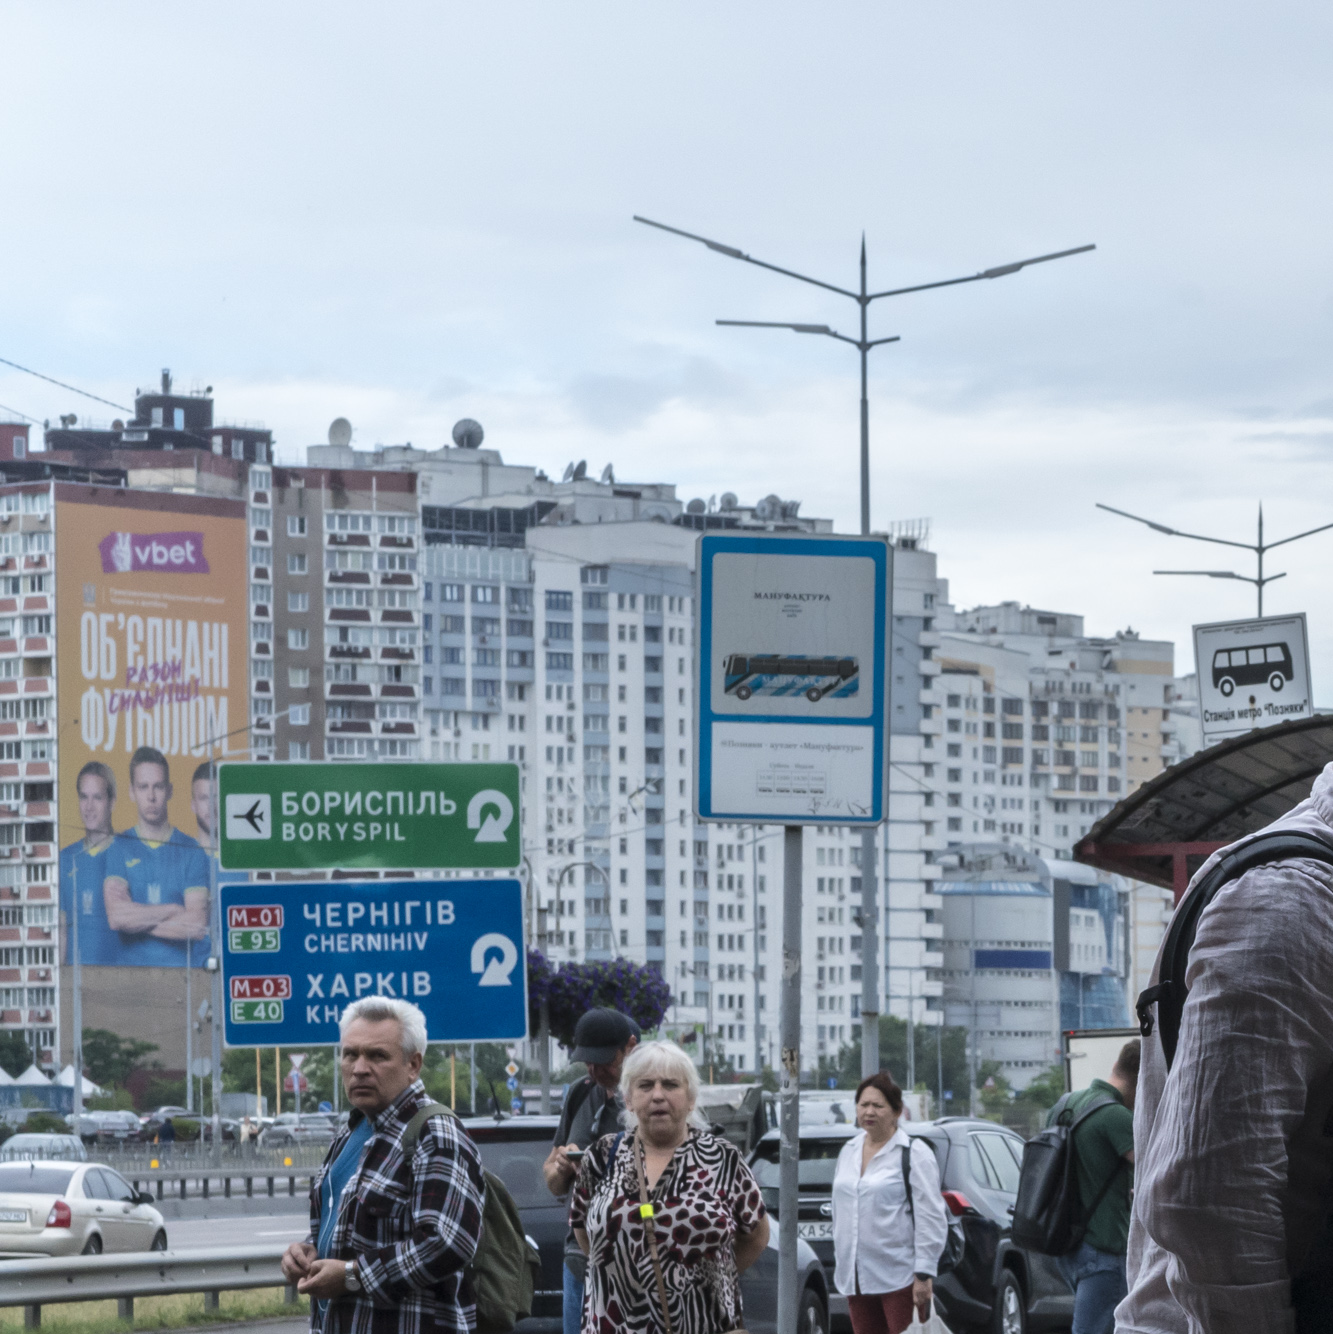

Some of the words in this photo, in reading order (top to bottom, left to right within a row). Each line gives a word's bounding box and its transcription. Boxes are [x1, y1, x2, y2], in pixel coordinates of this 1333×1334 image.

[134, 541, 196, 564] vbet
[125, 659, 182, 688] РАЗОМ
[1203, 706, 1236, 723] Станція
[1238, 707, 1262, 720] метро
[281, 791, 457, 816] БОРИСПІЛЬ
[282, 822, 406, 842] BORYSPIL
[303, 900, 456, 927] ЧЕРНІГІВ
[250, 931, 277, 949] 95
[304, 932, 429, 953] CHERNIHIV
[307, 971, 432, 998] ХАРКІВ
[254, 1002, 280, 1019] 40
